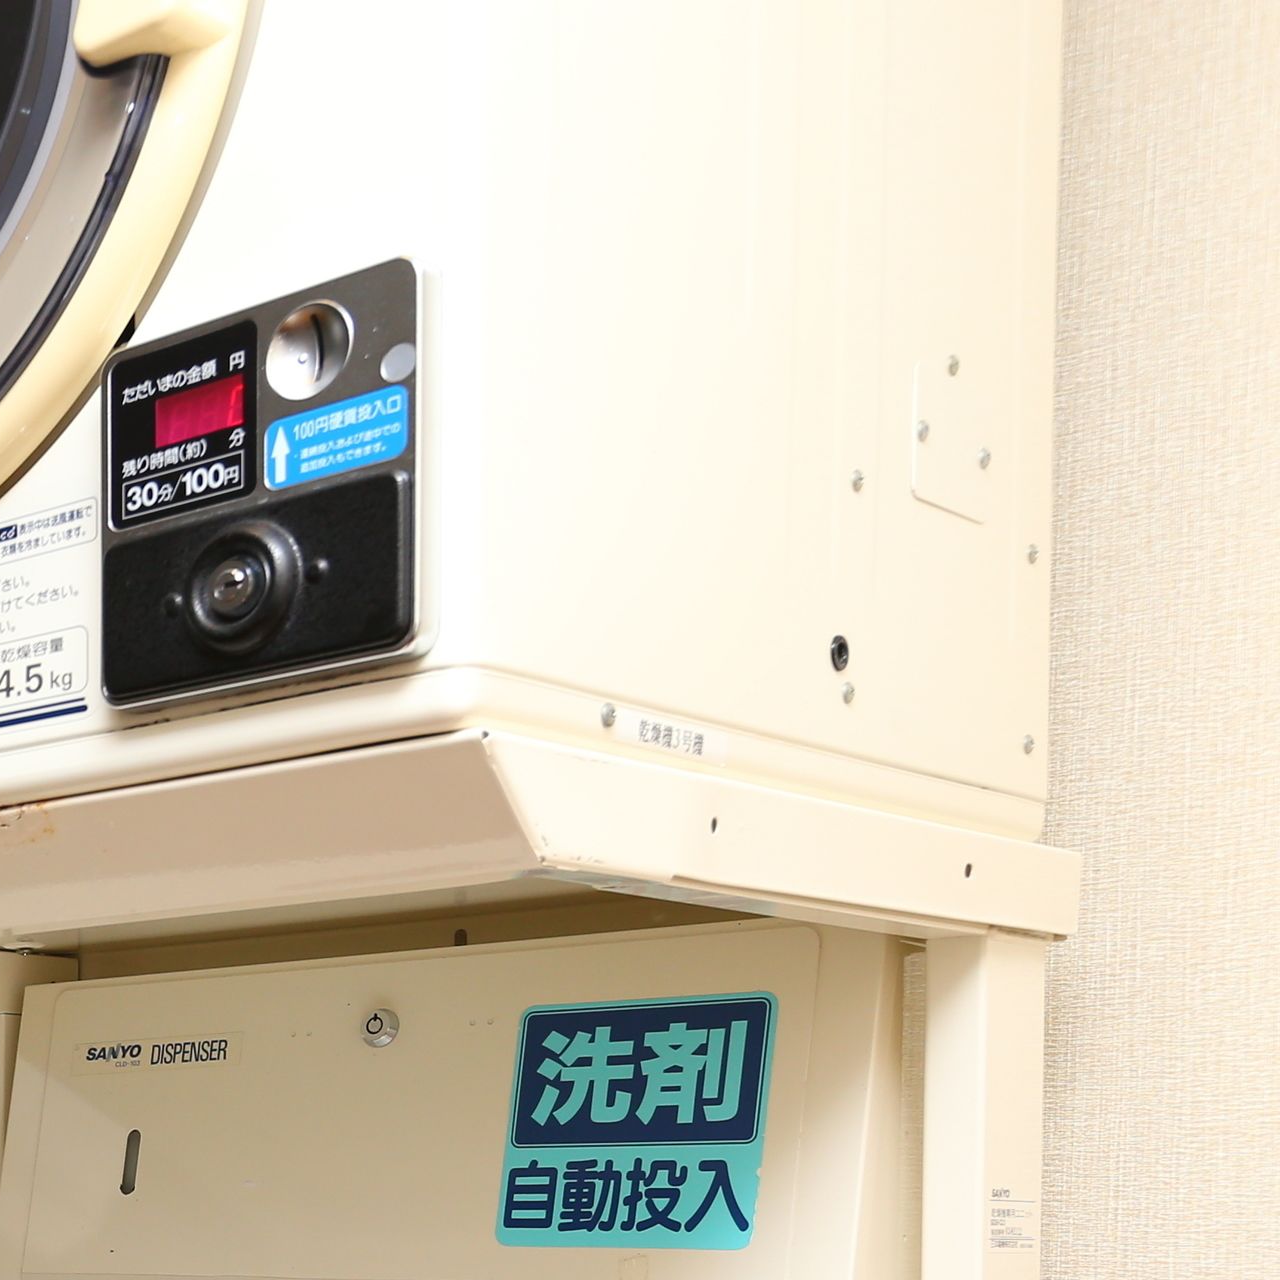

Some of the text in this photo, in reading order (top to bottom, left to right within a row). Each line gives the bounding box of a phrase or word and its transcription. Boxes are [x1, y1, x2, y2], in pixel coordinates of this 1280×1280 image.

[122, 350, 245, 405] ただいまの金額 円
[293, 394, 402, 440] 100円硬貨投入口
[229, 428, 246, 449] 分
[126, 462, 240, 512] 30分/100円
[1, 526, 87, 558] 衣類を冷ましています。
[0, 636, 64, 664] 乾燥容量
[639, 718, 704, 756] 乾燥機3号機
[86, 1040, 228, 1065] SANYO DISPENSER
[529, 1020, 748, 1127] 洗剤
[502, 1158, 750, 1233] 自動投入
